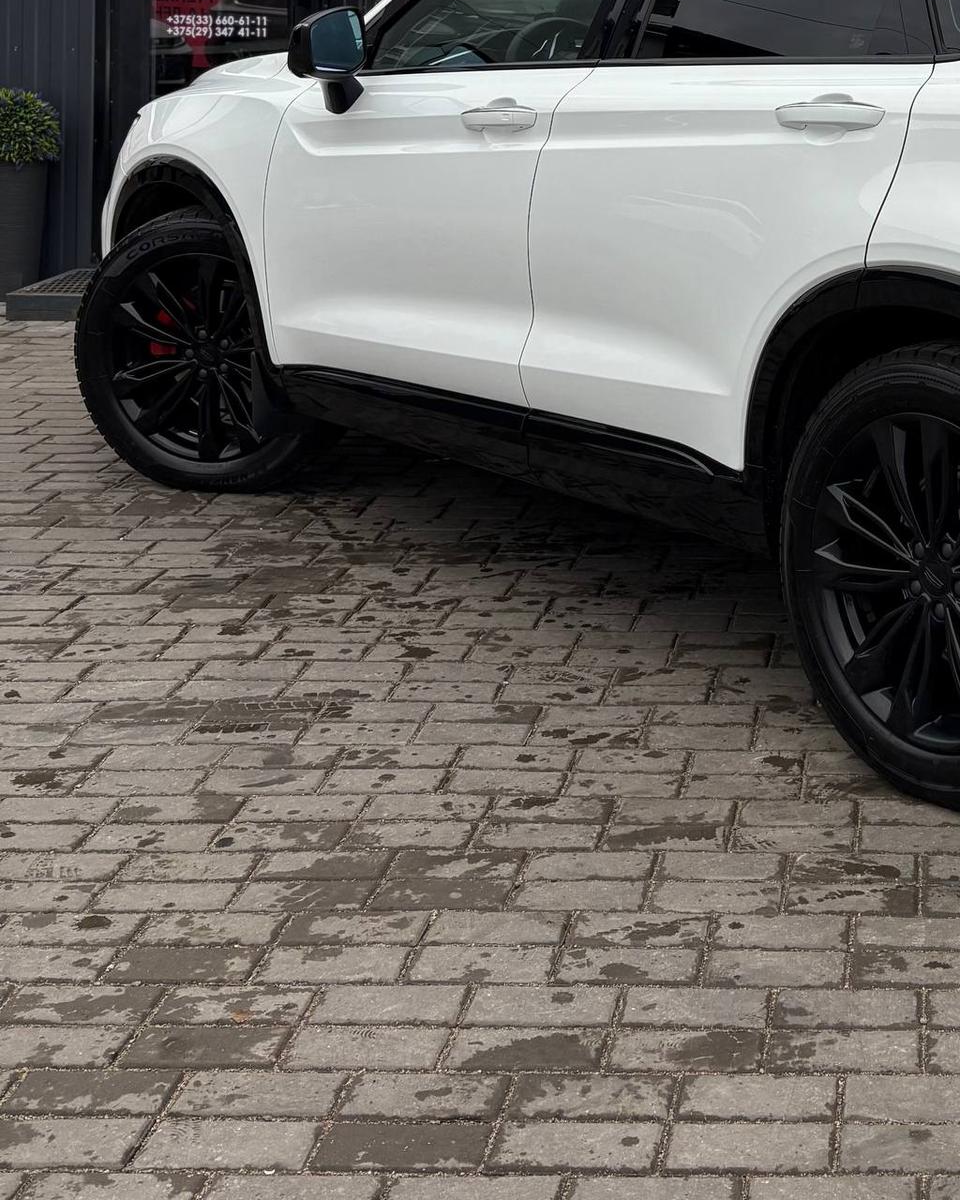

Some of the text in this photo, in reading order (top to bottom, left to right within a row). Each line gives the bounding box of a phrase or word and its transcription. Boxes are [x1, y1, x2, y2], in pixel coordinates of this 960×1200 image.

[166, 14, 267, 26] +375(33) 660-61-11
[166, 26, 267, 38] +375(29) 347 41-11
